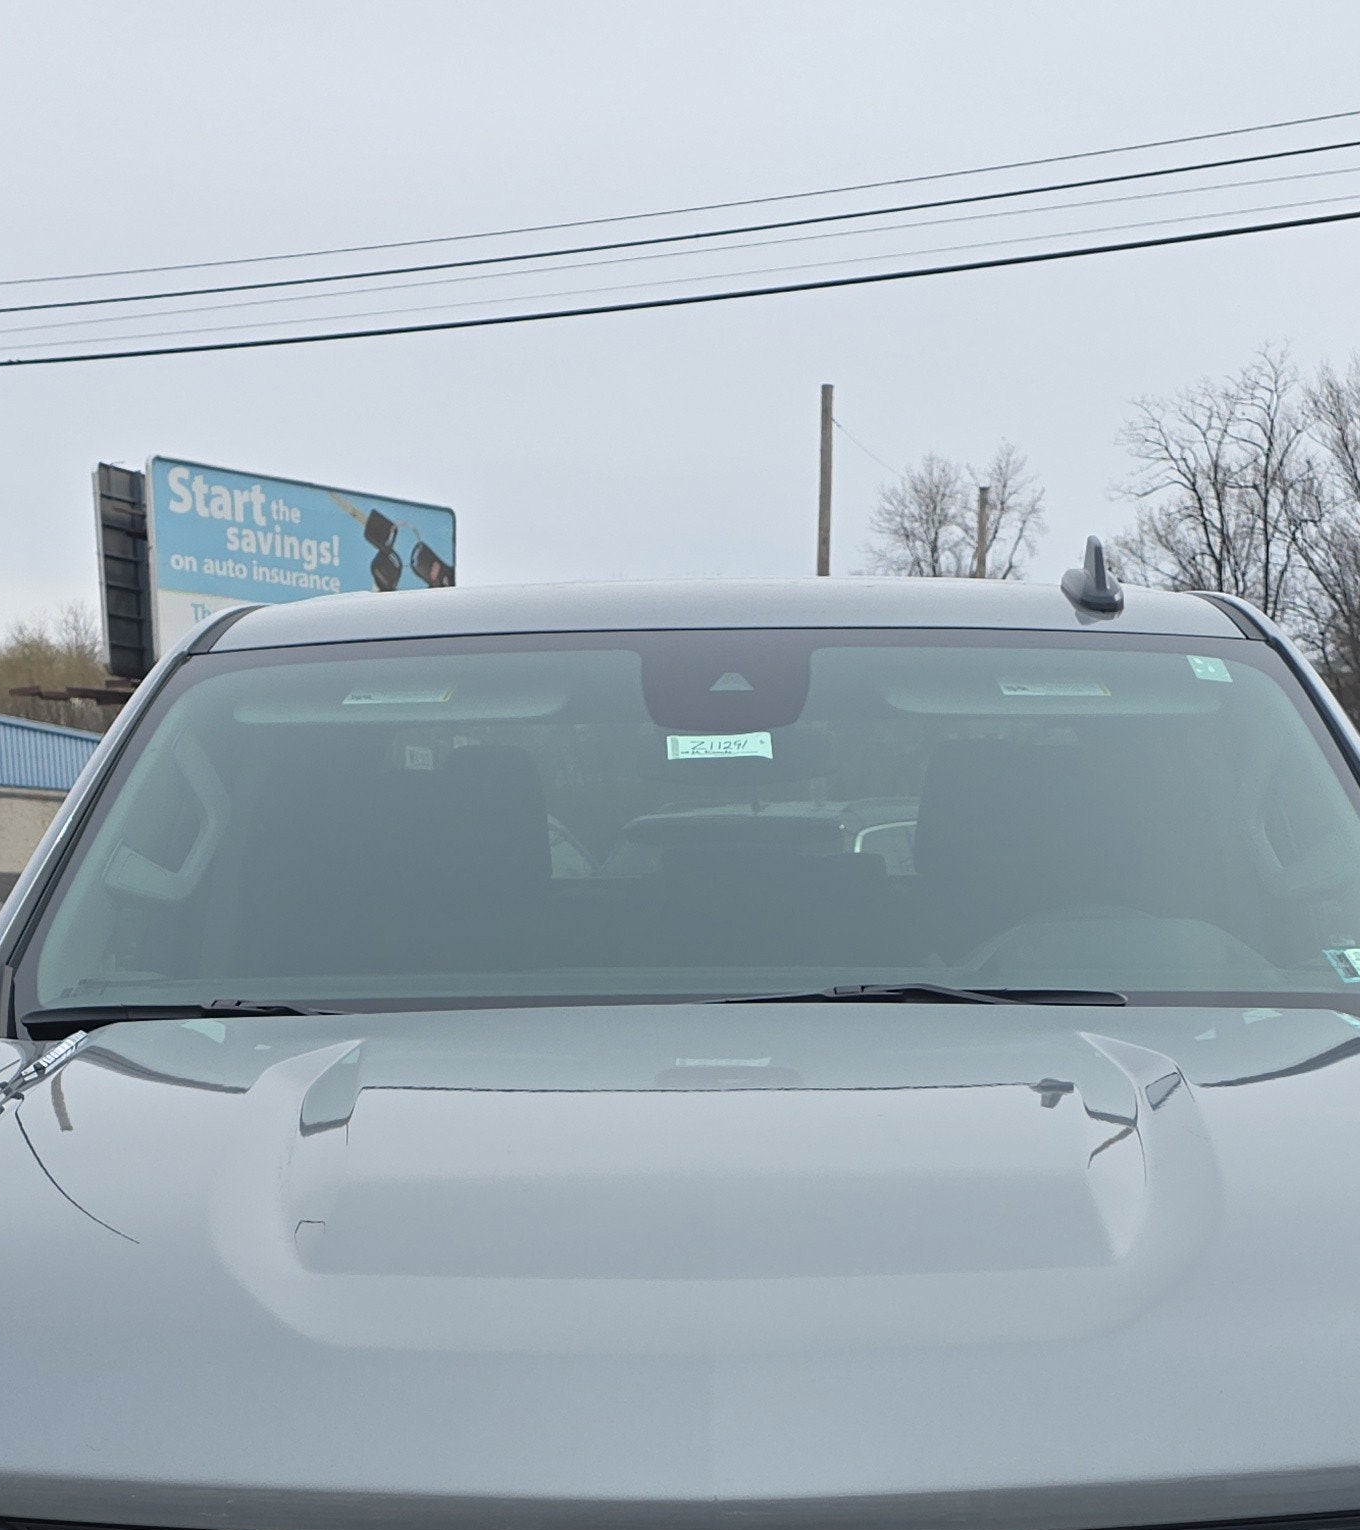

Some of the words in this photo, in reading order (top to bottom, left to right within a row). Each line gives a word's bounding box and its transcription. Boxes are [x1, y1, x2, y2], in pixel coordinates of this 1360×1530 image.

[168, 465, 266, 526] Start
[270, 499, 301, 524] the
[226, 525, 340, 571] savings!
[170, 553, 197, 572] on
[203, 557, 248, 579] auto
[253, 561, 340, 594] insurance
